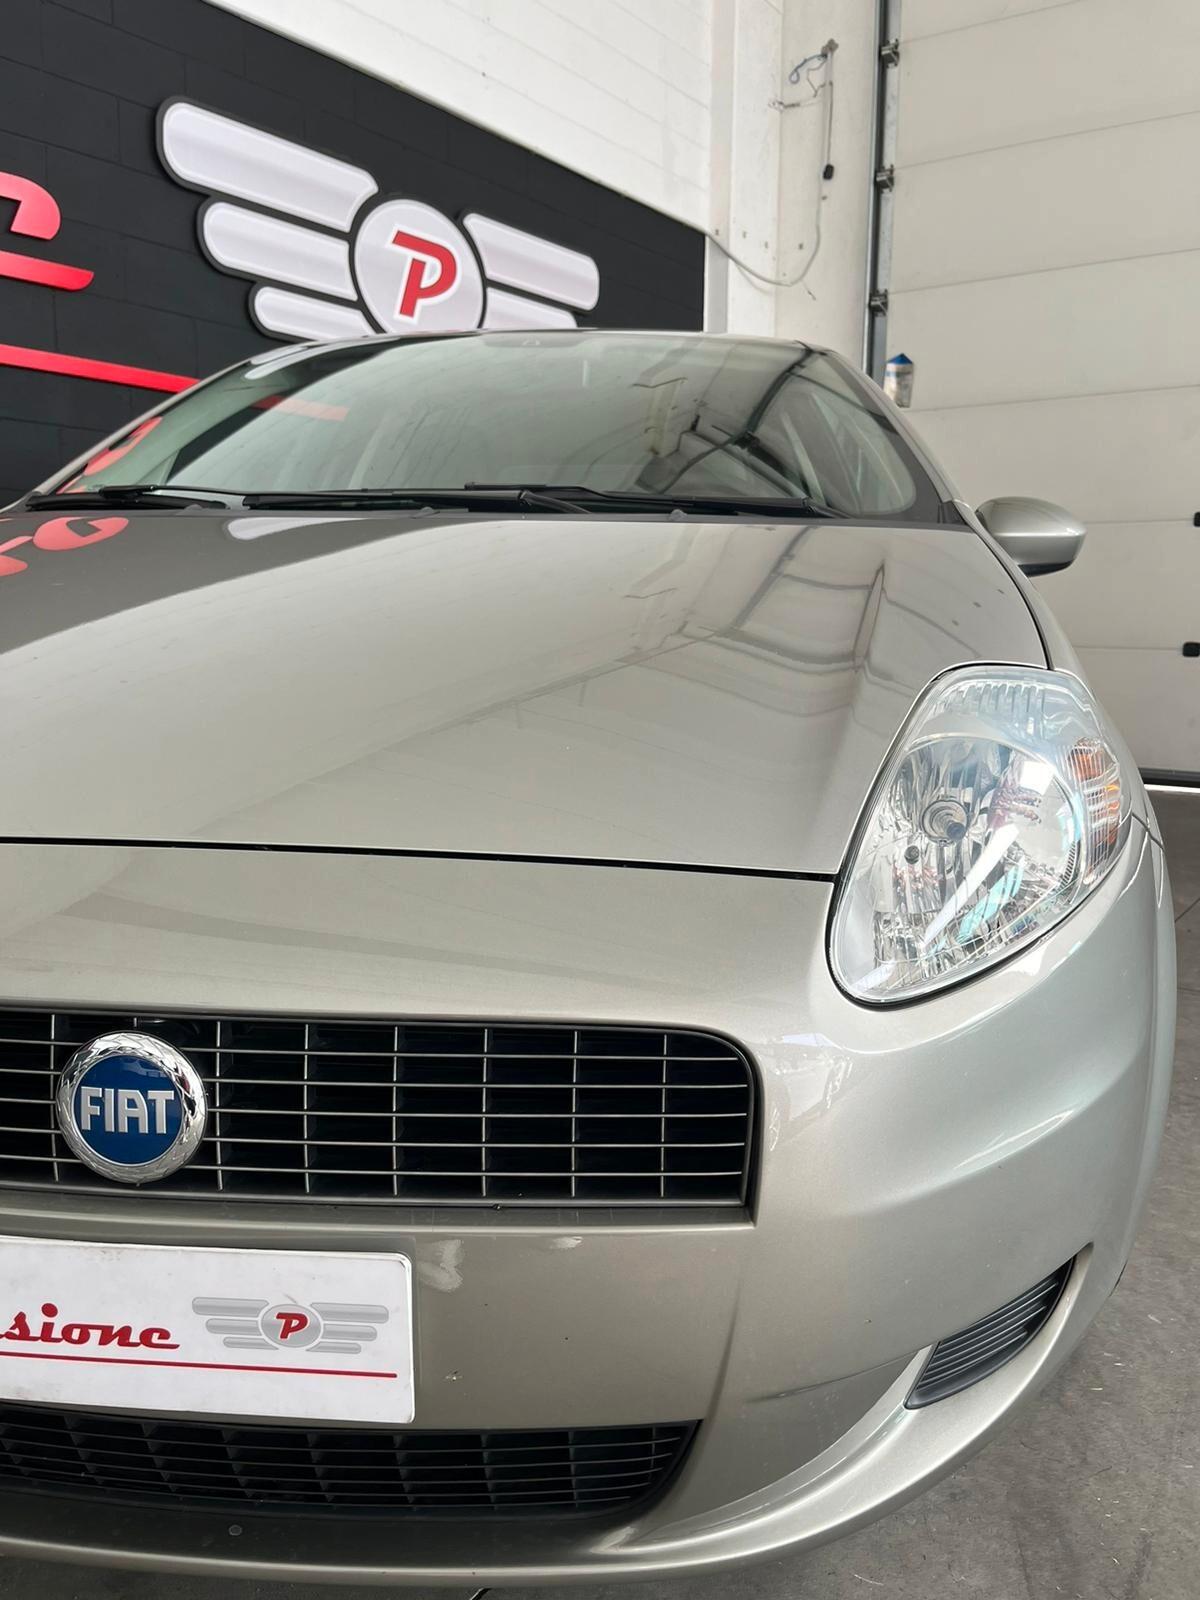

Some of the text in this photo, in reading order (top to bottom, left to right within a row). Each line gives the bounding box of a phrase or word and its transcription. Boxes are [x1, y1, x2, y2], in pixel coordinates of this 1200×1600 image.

[391, 229, 458, 319] P
[80, 1086, 175, 1135] FIAT
[275, 1312, 309, 1340] P
